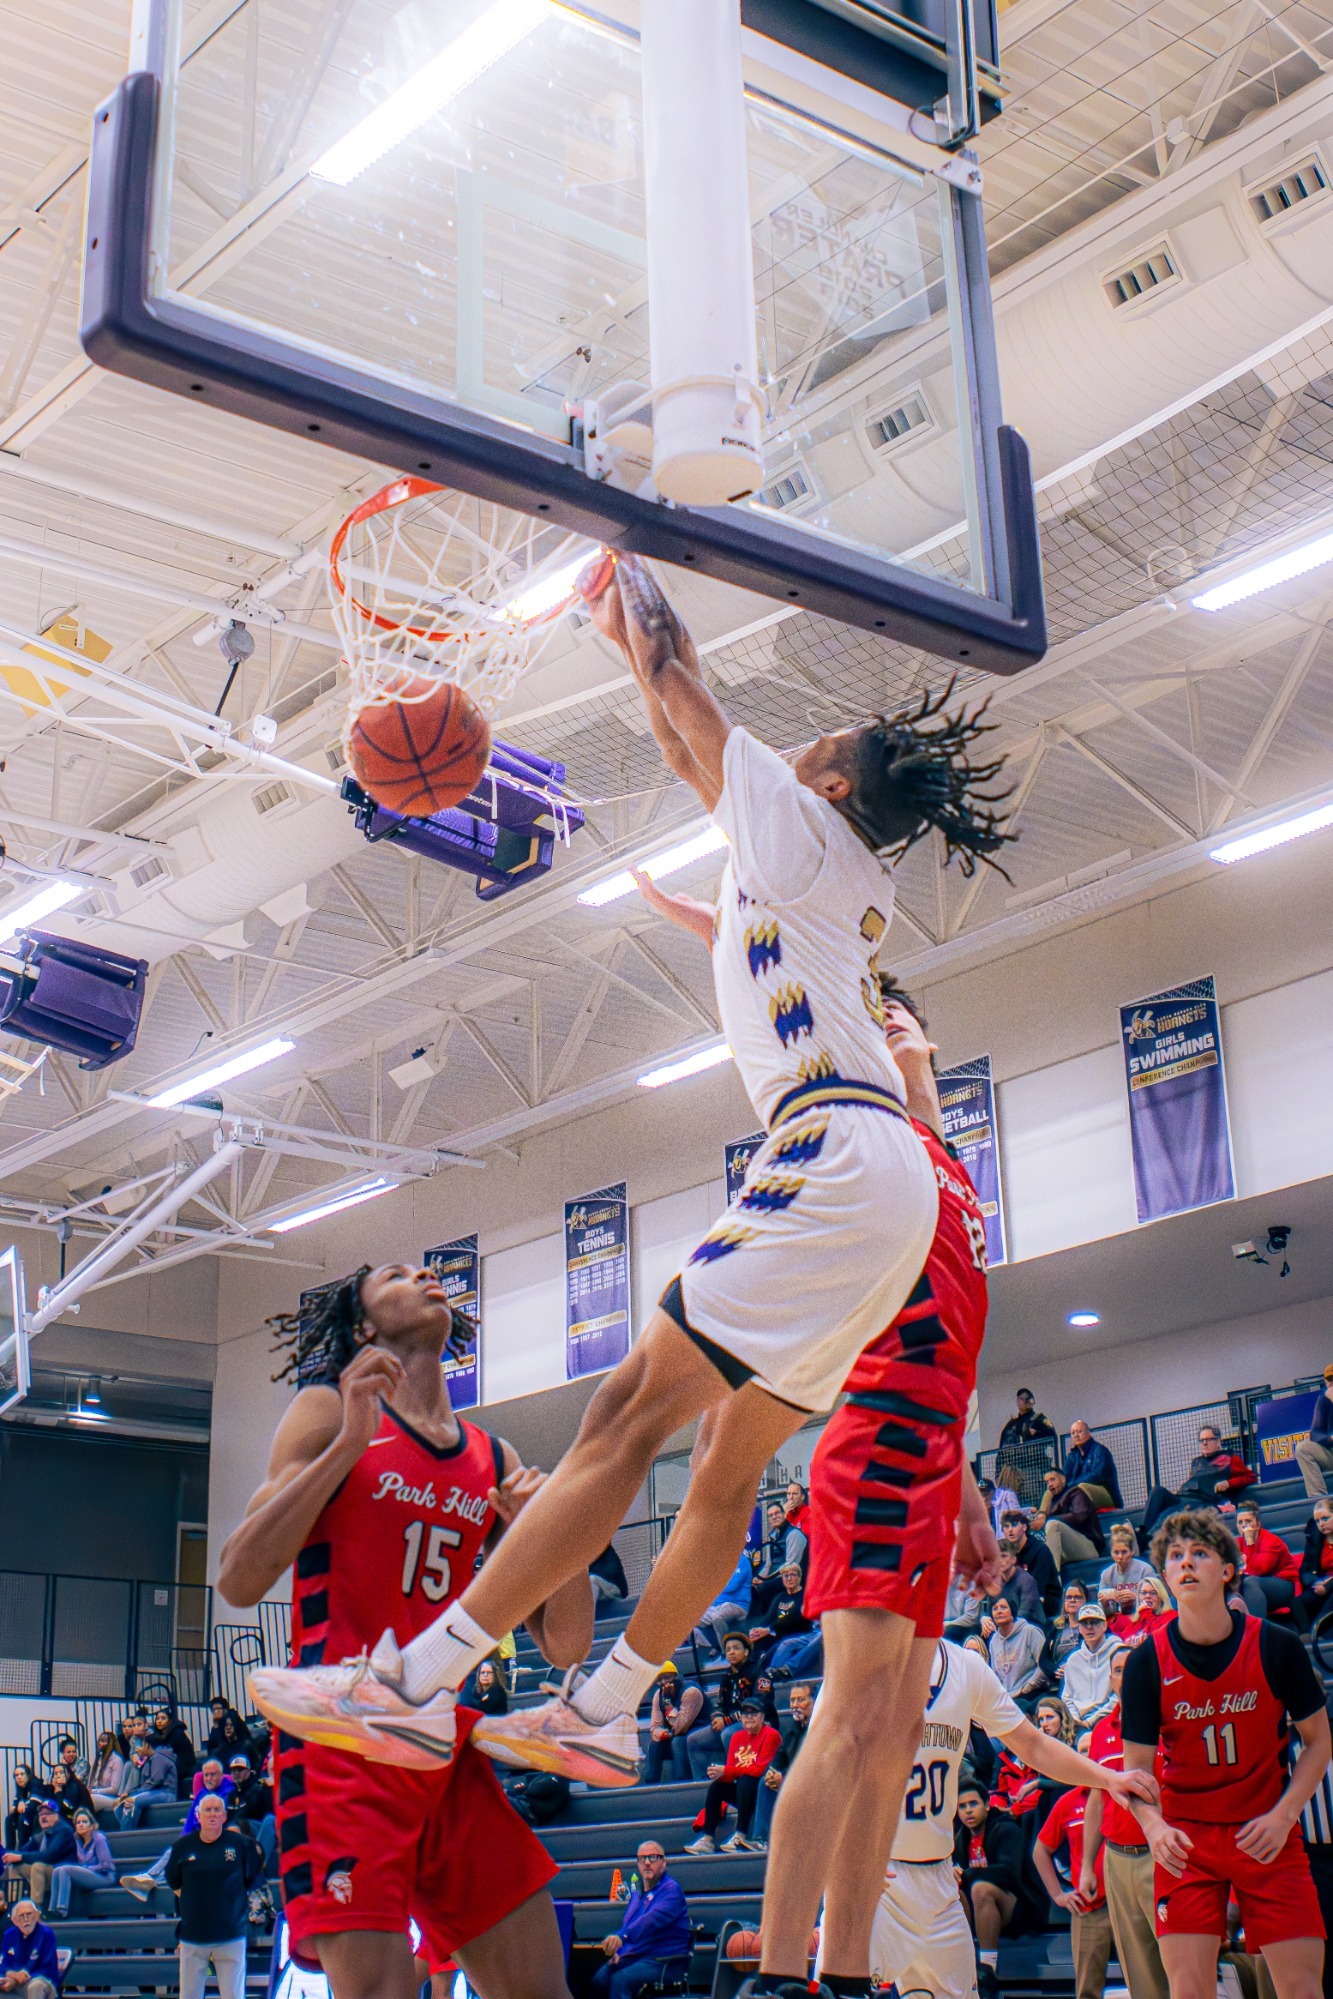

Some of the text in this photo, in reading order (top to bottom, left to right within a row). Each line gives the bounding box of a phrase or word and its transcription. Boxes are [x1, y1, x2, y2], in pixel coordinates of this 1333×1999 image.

[1156, 1007, 1207, 1033] HORNETS
[1129, 1032, 1215, 1074] SWIMMING
[1155, 1031, 1185, 1049] GIRLS
[577, 1231, 616, 1255] TENNIS
[585, 1226, 605, 1239] BOYS
[372, 1471, 489, 1526] Park Hill
[402, 1520, 464, 1605] 15
[1174, 1690, 1259, 1720] Park Hill
[1202, 1722, 1239, 1767] 11
[905, 1759, 950, 1821] 20
